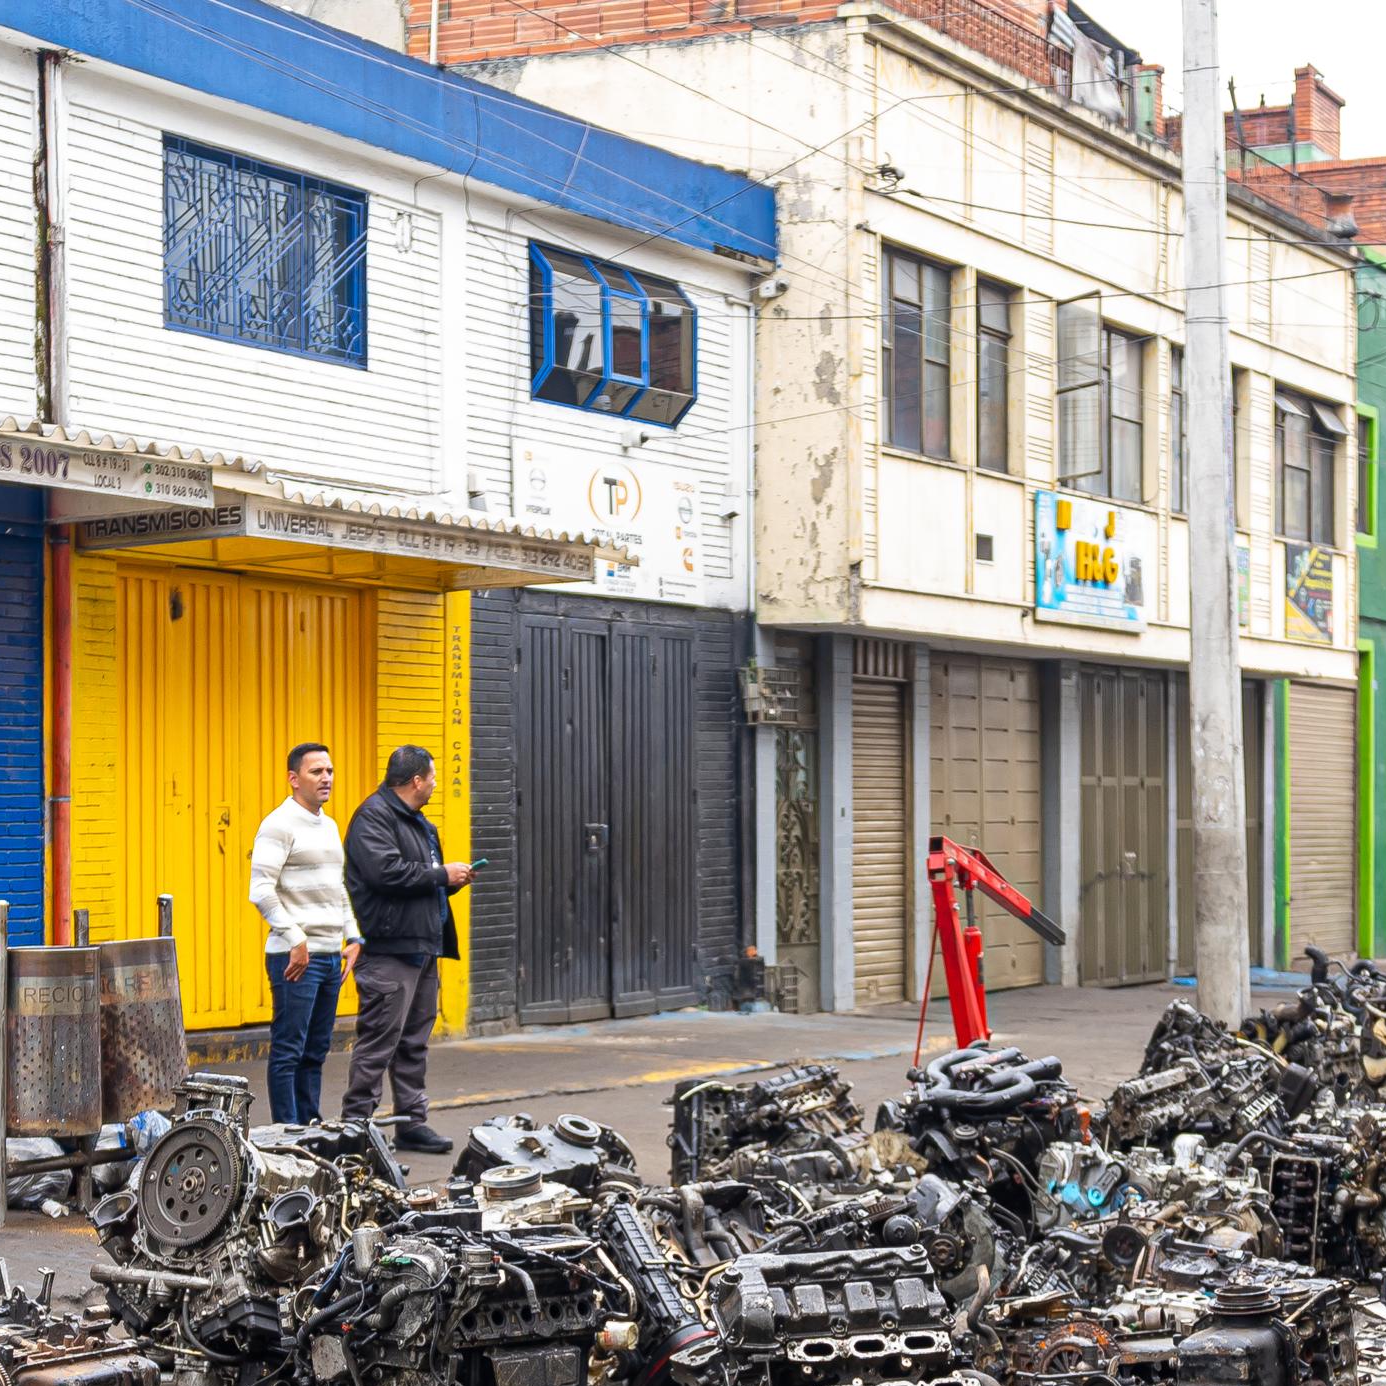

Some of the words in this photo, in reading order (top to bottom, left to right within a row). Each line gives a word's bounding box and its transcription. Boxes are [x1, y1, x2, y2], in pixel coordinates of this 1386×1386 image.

[20, 446, 71, 479] 2007
[82, 453, 95, 466] CLL
[96, 455, 101, 467] 8
[154, 464, 169, 477] 302
[171, 466, 186, 479] 310
[94, 474, 115, 489] LOCAL
[117, 477, 122, 489] 3
[155, 484, 170, 495] 310
[172, 486, 187, 497] 868
[85, 506, 242, 538] TRANSMISIONES
[257, 510, 333, 538] UNIVERSAL
[452, 626, 463, 725] TRANSMISION
[453, 741, 462, 798] CAJAS
